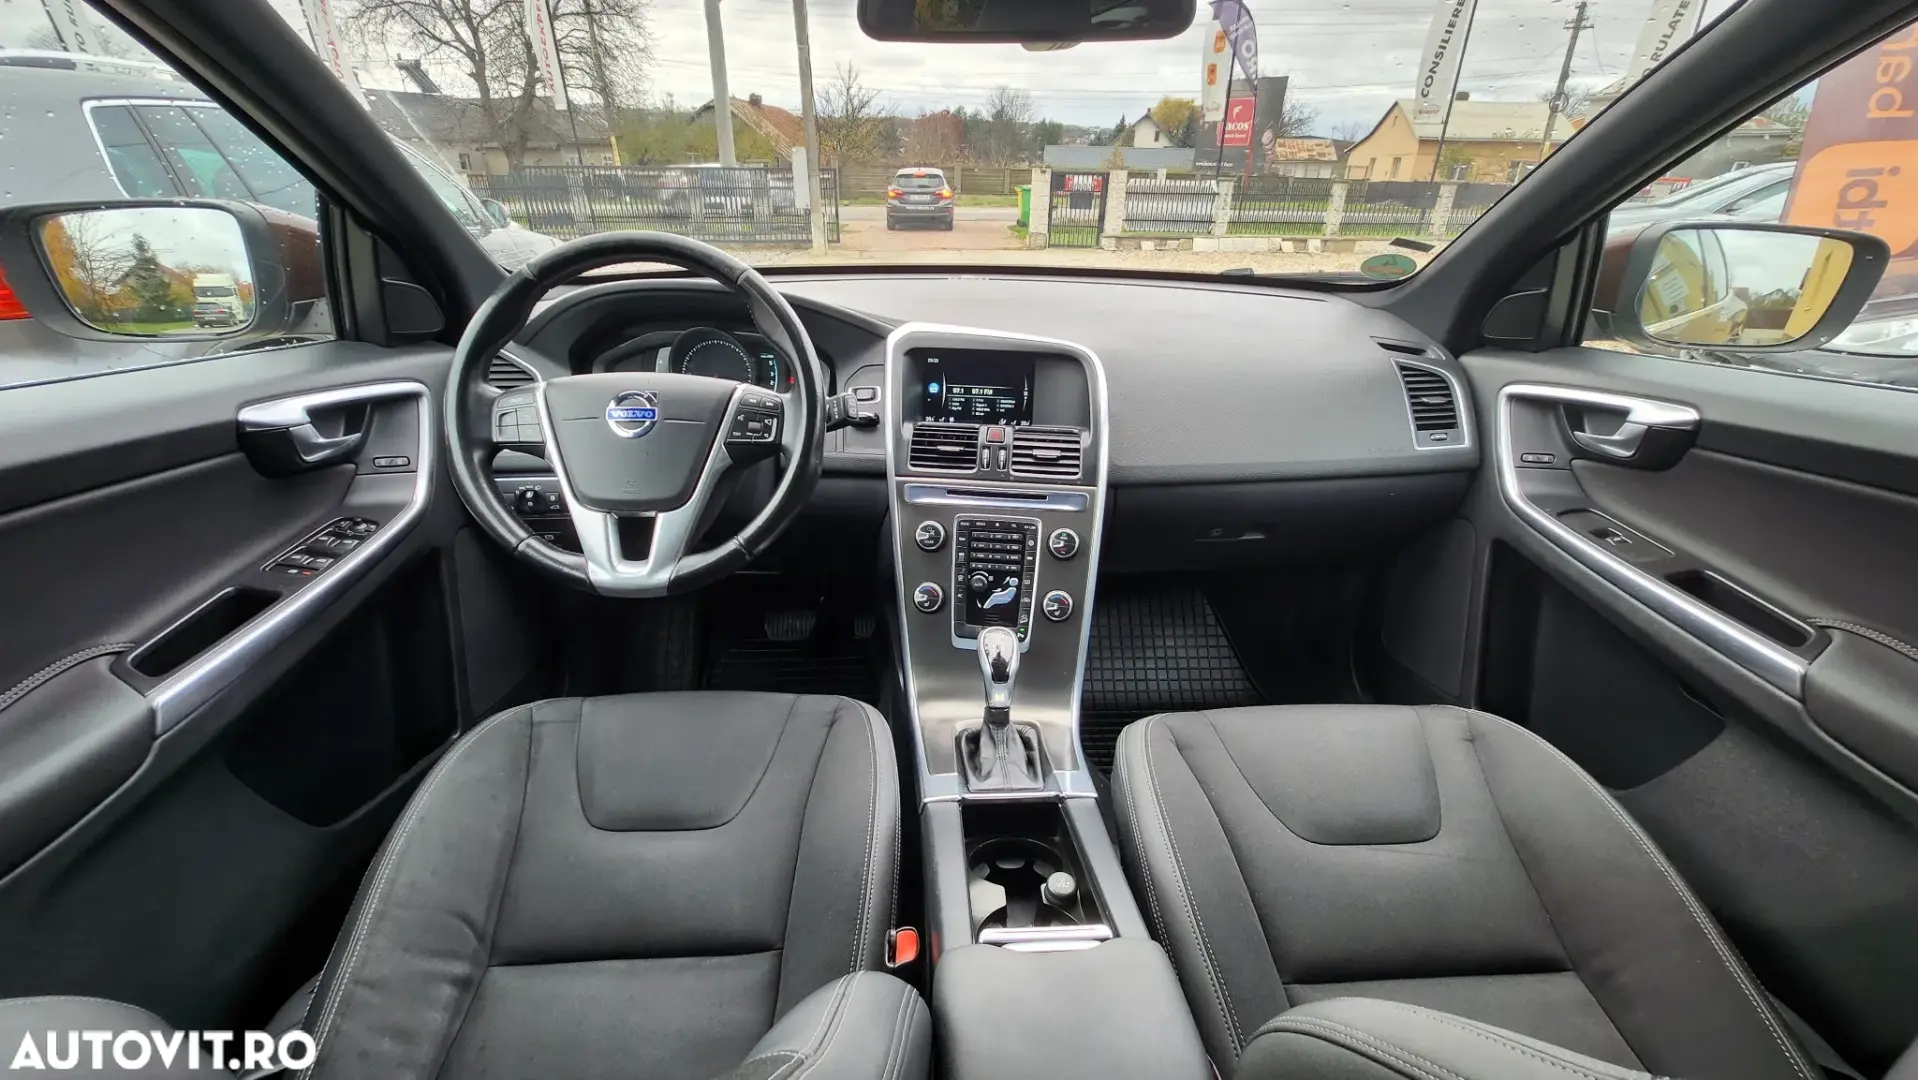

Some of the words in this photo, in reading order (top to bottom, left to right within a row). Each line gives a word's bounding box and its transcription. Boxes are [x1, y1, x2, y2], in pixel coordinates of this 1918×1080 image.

[535, 0, 557, 95] AUTOEXPE
[1225, 122, 1249, 131] acos
[609, 410, 654, 418] VOLVO
